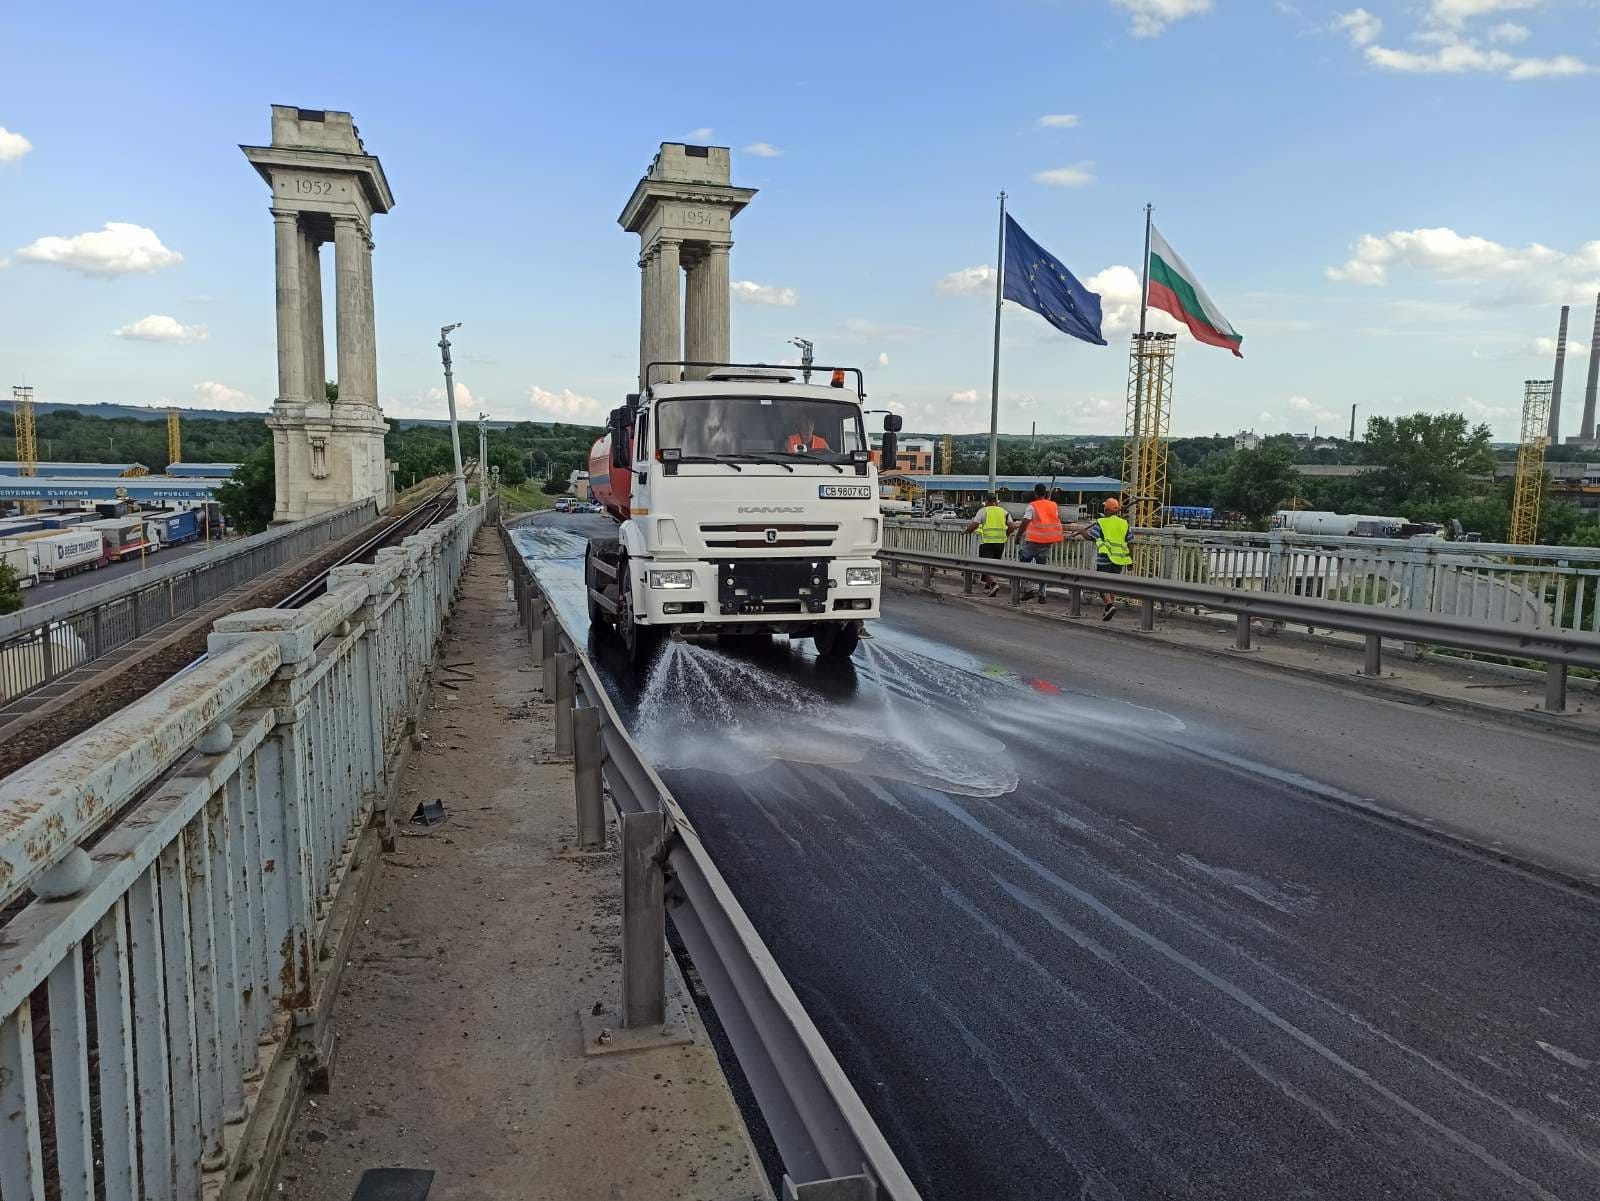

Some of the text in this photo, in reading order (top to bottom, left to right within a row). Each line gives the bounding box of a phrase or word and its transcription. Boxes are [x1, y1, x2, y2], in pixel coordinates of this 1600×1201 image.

[295, 179, 332, 195] 1952
[682, 209, 711, 225] 1954
[825, 487, 869, 497] CB 9807 KC
[737, 506, 805, 514] KAMAZ
[78, 539, 100, 553] TRANSPORT
